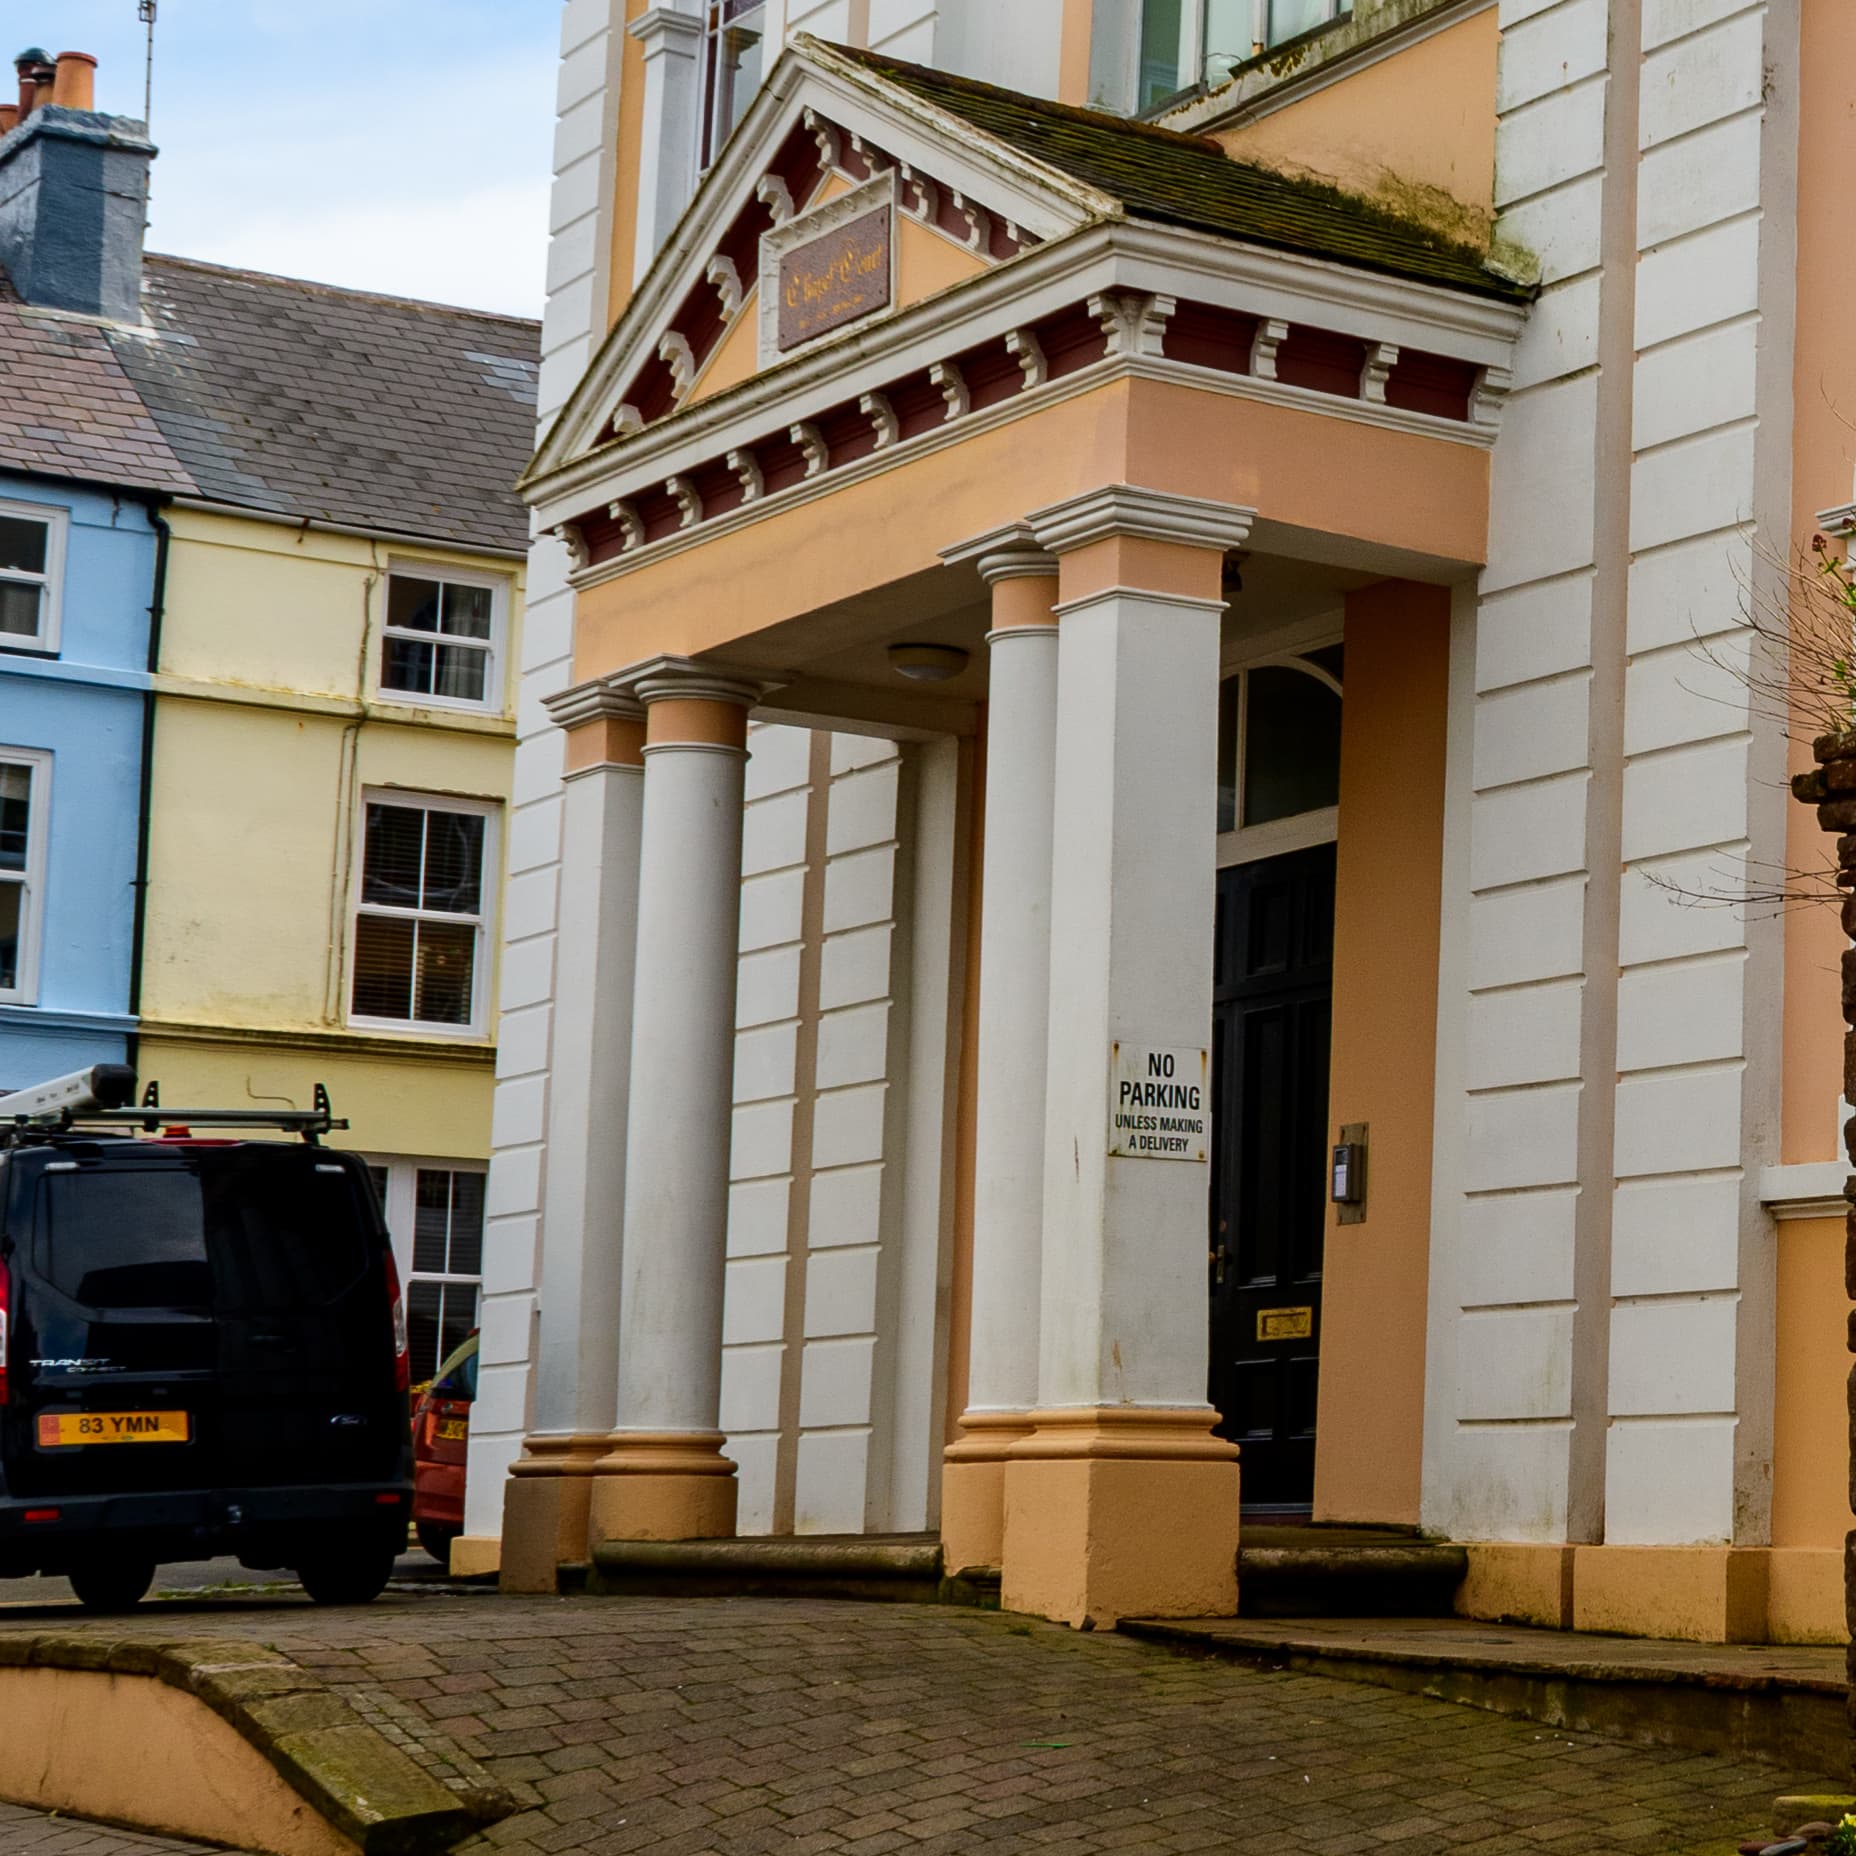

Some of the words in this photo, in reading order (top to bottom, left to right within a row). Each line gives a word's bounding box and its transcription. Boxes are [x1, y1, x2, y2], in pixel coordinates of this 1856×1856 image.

[1148, 1052, 1175, 1078] NO
[1119, 1080, 1201, 1111] PARKING
[1115, 1113, 1157, 1131] UNLESS
[1159, 1116, 1203, 1134] MAKING
[1128, 1134, 1137, 1150] A
[1139, 1135, 1189, 1153] DELIVERY
[79, 1417, 104, 1434] 83
[110, 1415, 160, 1433] YMN
